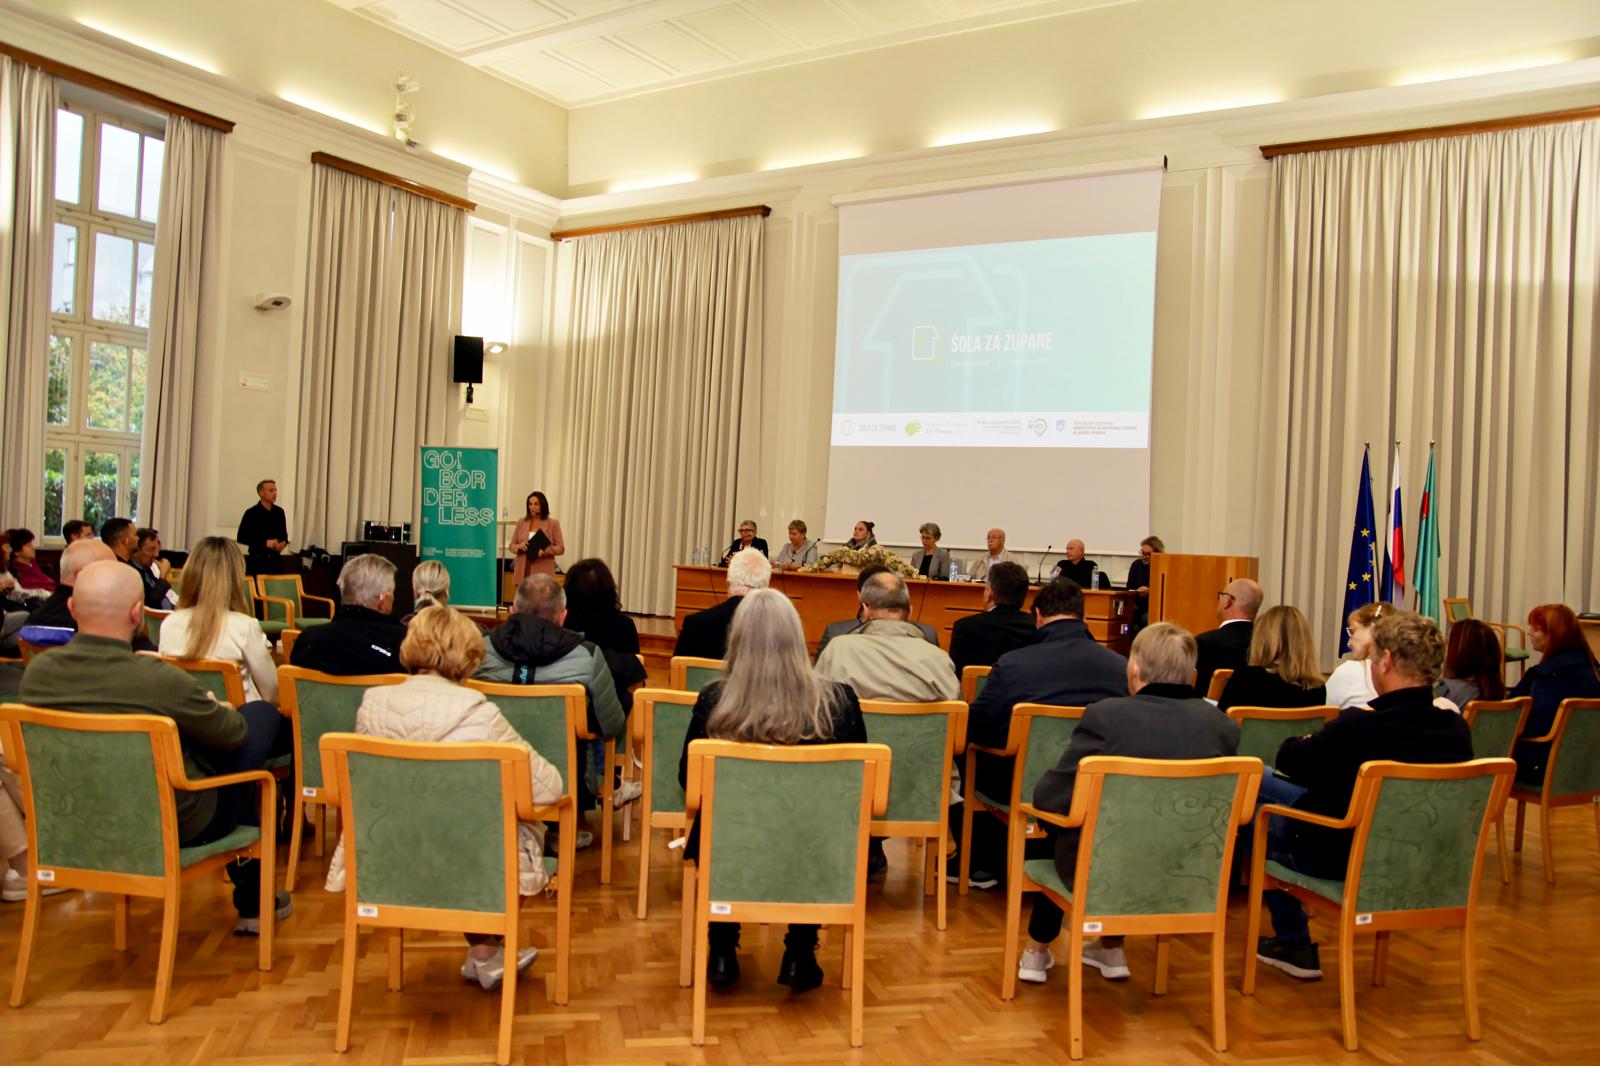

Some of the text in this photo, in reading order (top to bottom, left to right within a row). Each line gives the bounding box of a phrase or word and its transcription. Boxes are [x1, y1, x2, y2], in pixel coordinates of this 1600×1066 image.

[951, 331, 1054, 353] ŠOLA ZA ŽUPANE
[424, 450, 462, 469] GO!
[439, 469, 486, 489] BOR
[424, 488, 468, 507] DER
[438, 507, 494, 526] LESS
